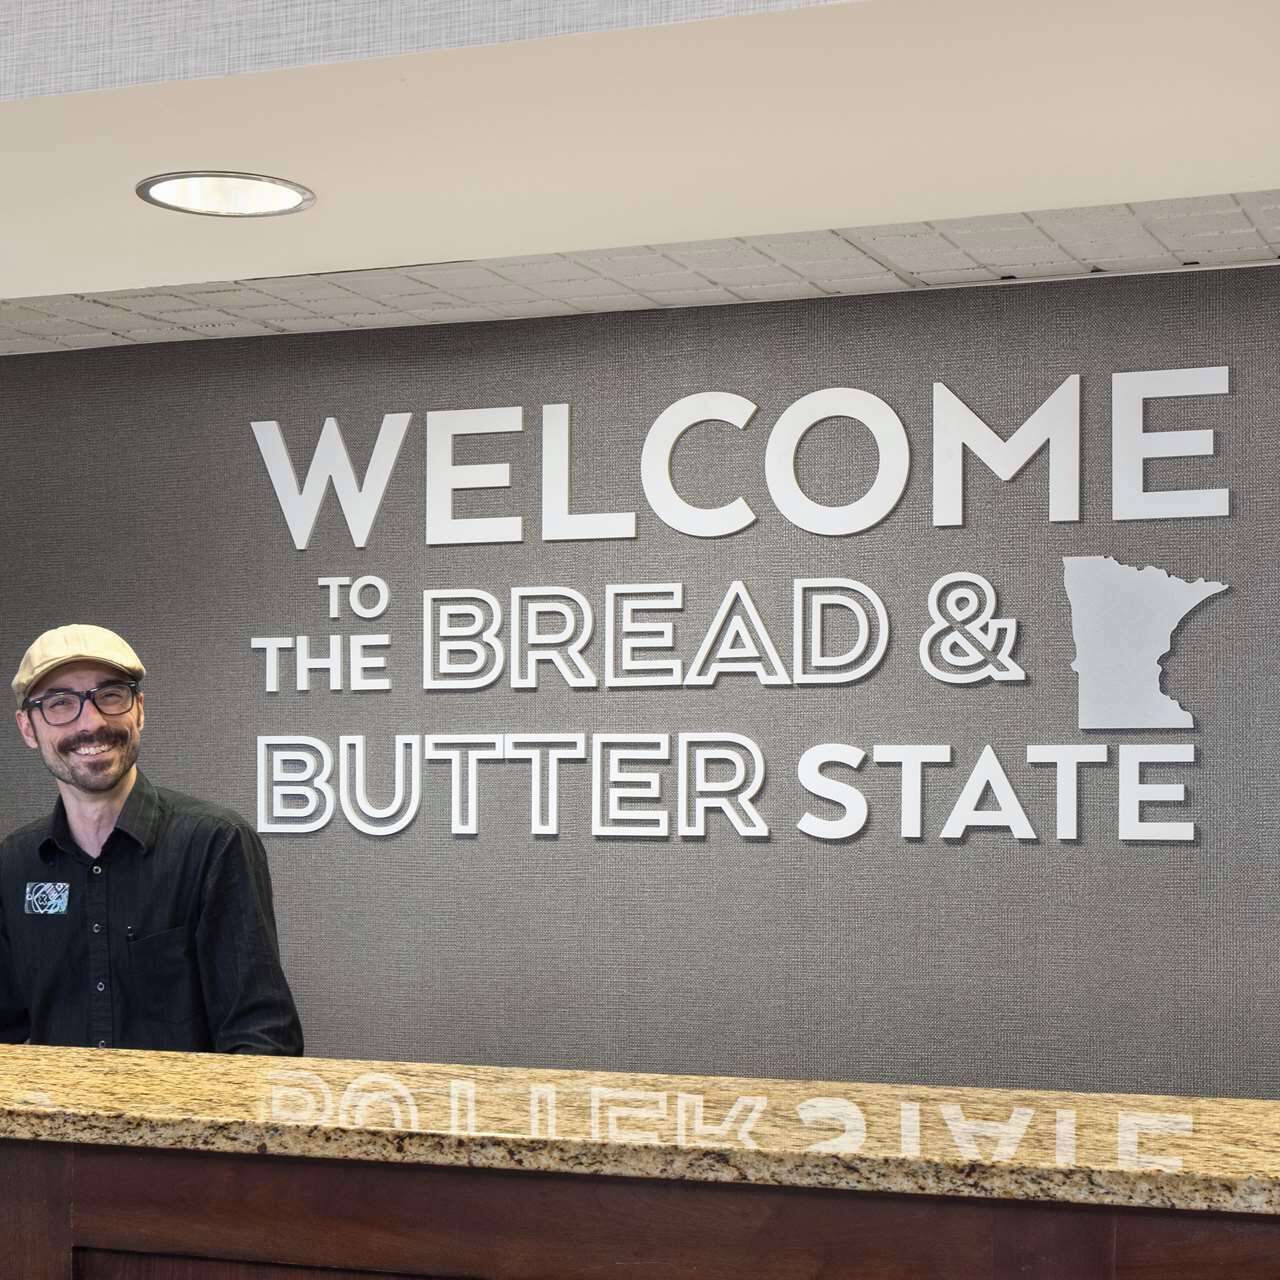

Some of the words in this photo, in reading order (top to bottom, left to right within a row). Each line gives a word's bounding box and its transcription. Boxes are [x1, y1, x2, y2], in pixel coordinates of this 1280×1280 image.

[251, 366, 1230, 550] WELCOME
[250, 634, 391, 692] THE
[422, 580, 890, 690] BREAD
[919, 572, 1026, 684] &
[317, 576, 390, 618] TO
[256, 730, 771, 838] BUTTER
[796, 743, 1196, 840] STATE
